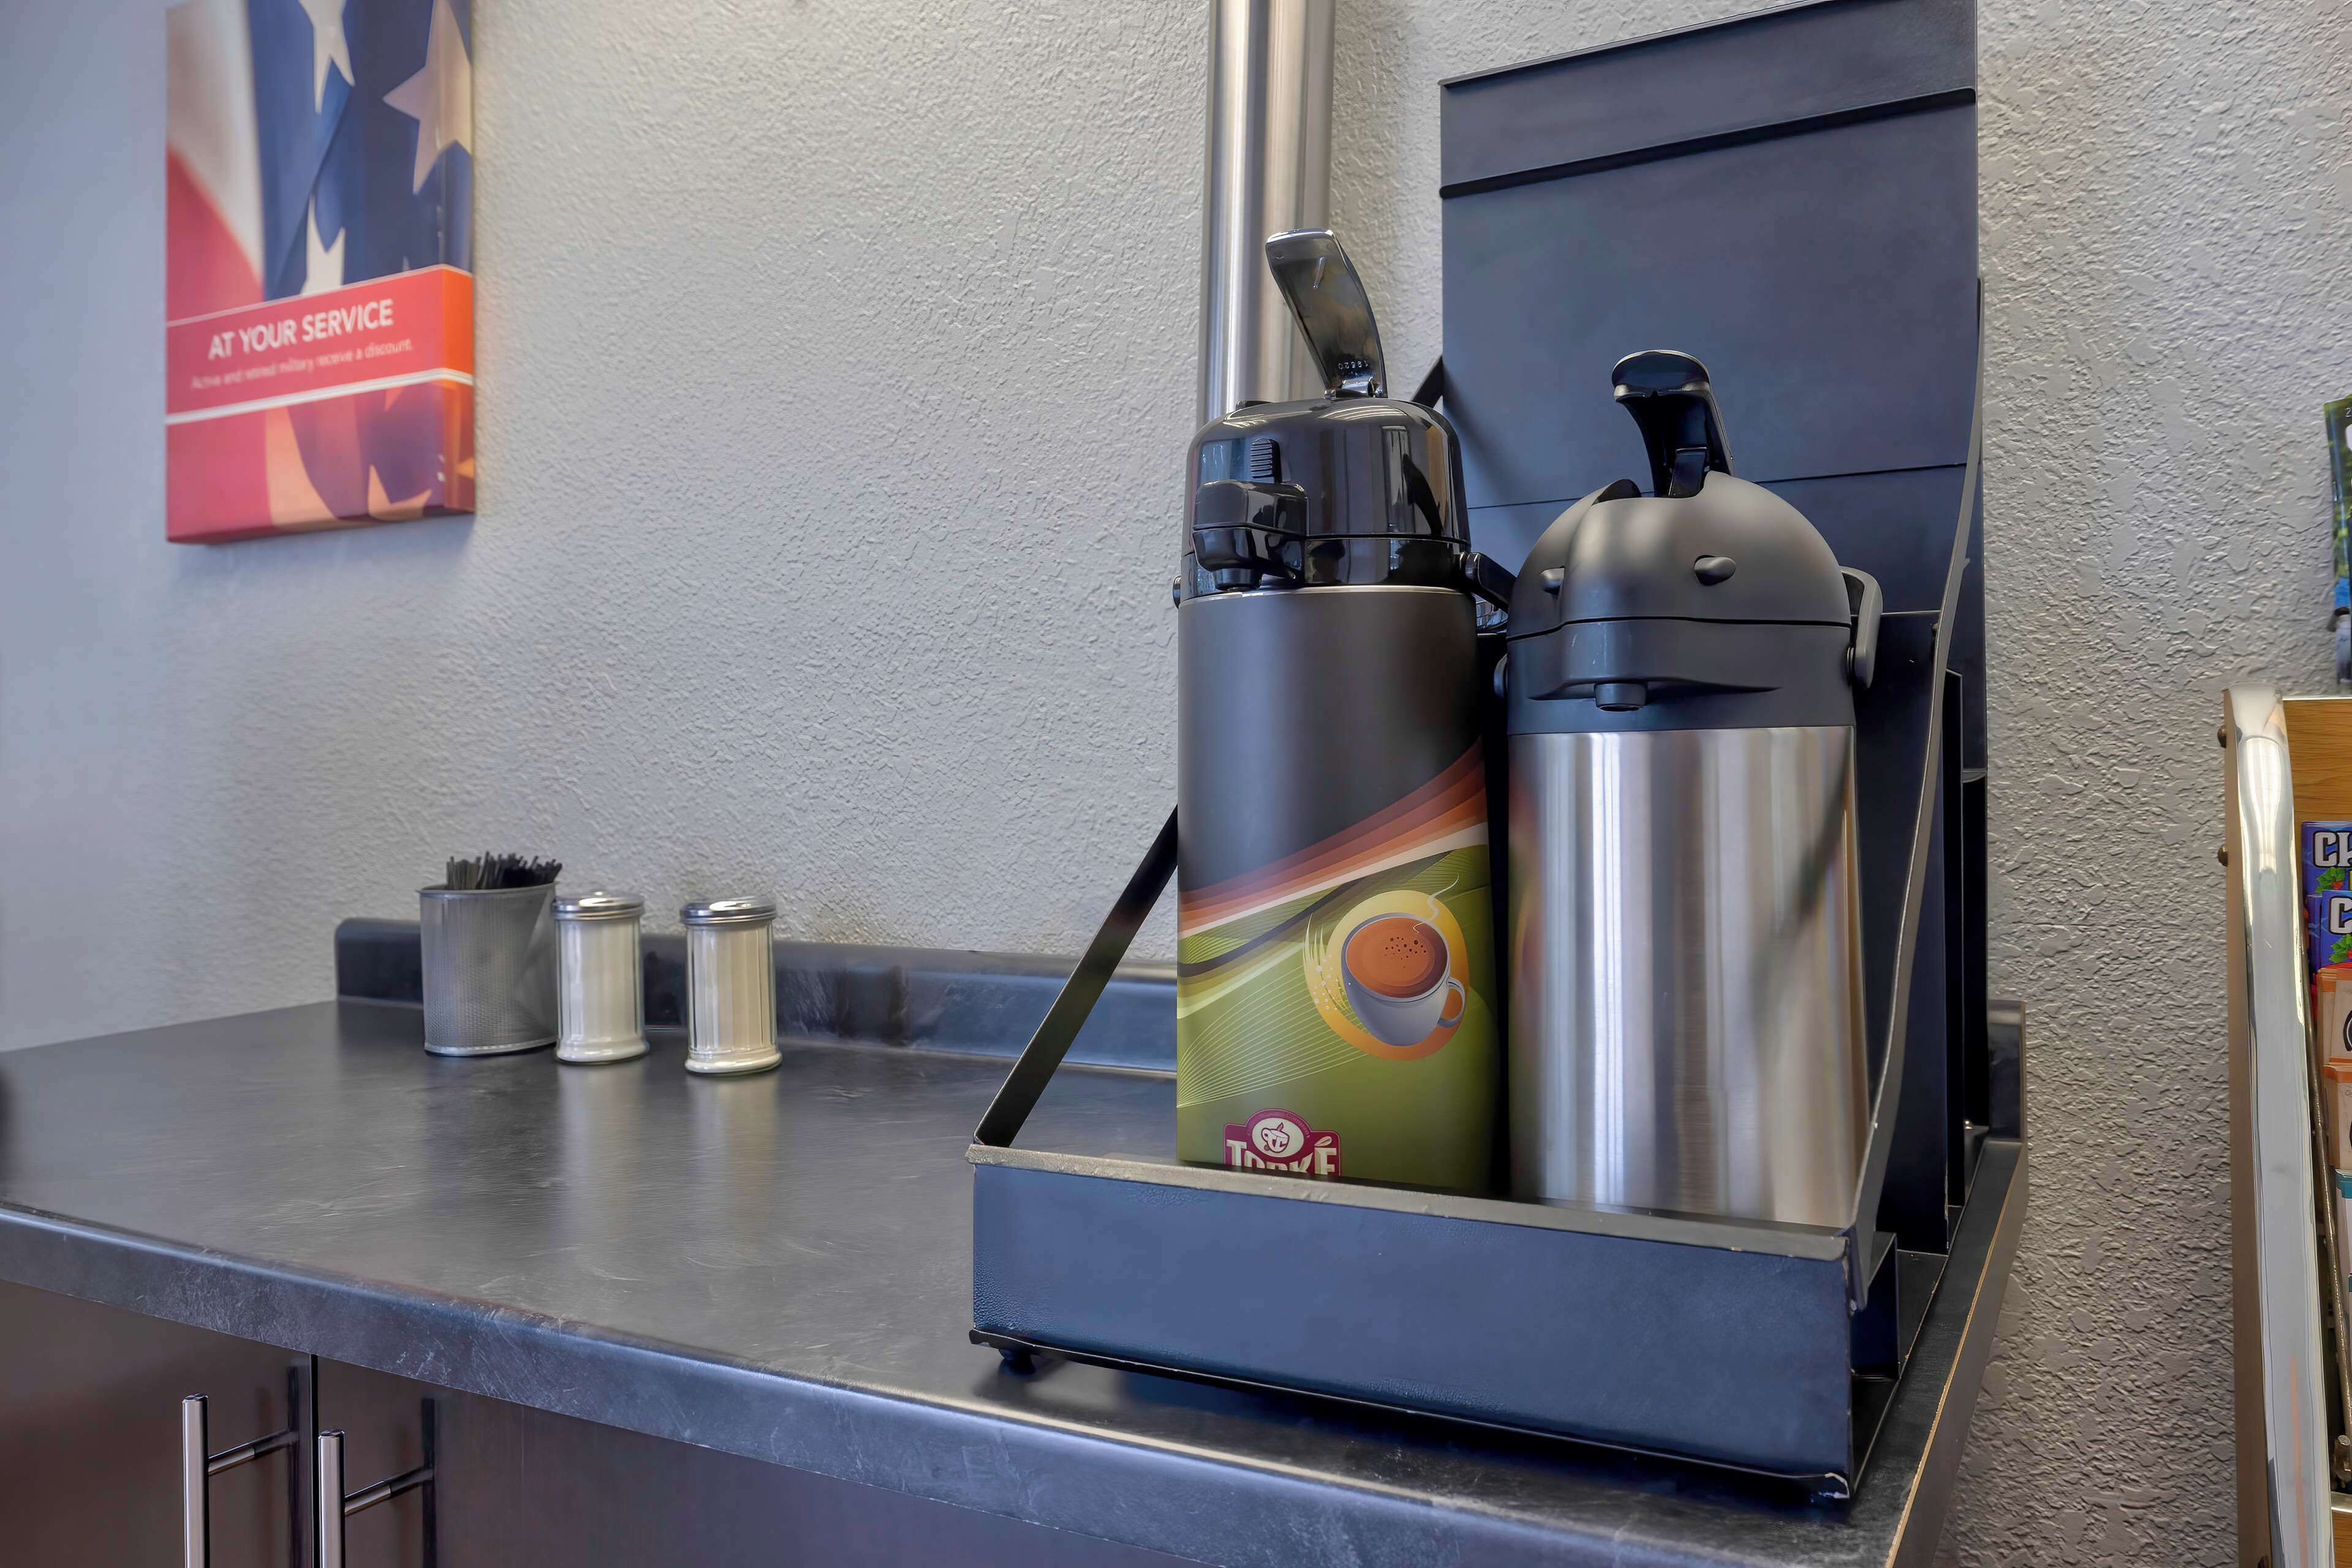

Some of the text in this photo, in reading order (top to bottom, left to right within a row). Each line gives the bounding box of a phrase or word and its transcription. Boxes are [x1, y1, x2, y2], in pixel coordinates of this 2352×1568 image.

[208, 299, 393, 360] AT YOUR SERVICE
[224, 369, 243, 385] and
[245, 363, 276, 380] retired
[279, 358, 314, 374] military
[317, 351, 353, 366] receive
[355, 348, 363, 360] a
